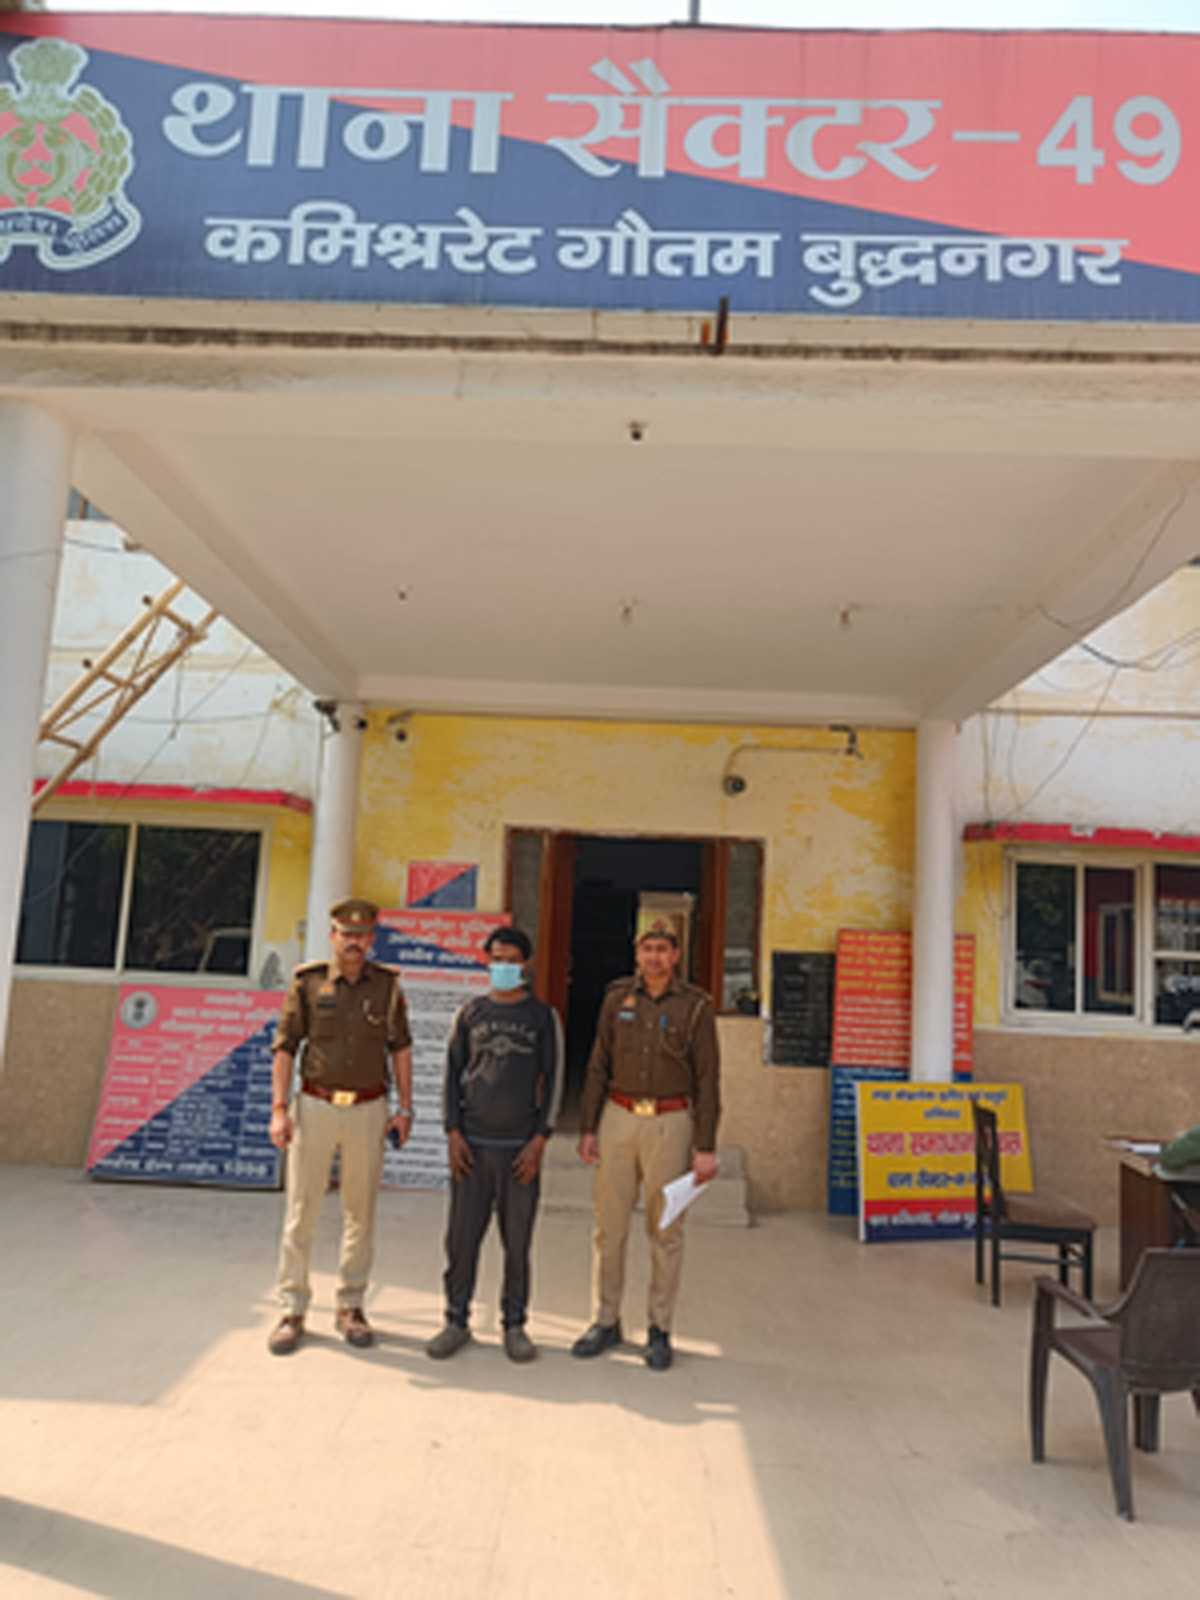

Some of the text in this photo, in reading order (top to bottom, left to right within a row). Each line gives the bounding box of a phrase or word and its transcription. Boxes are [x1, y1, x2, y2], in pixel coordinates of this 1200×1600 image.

[162, 82, 513, 174] थाना
[556, 209, 780, 278] गौतम
[800, 232, 1131, 307] बुद्धनगर
